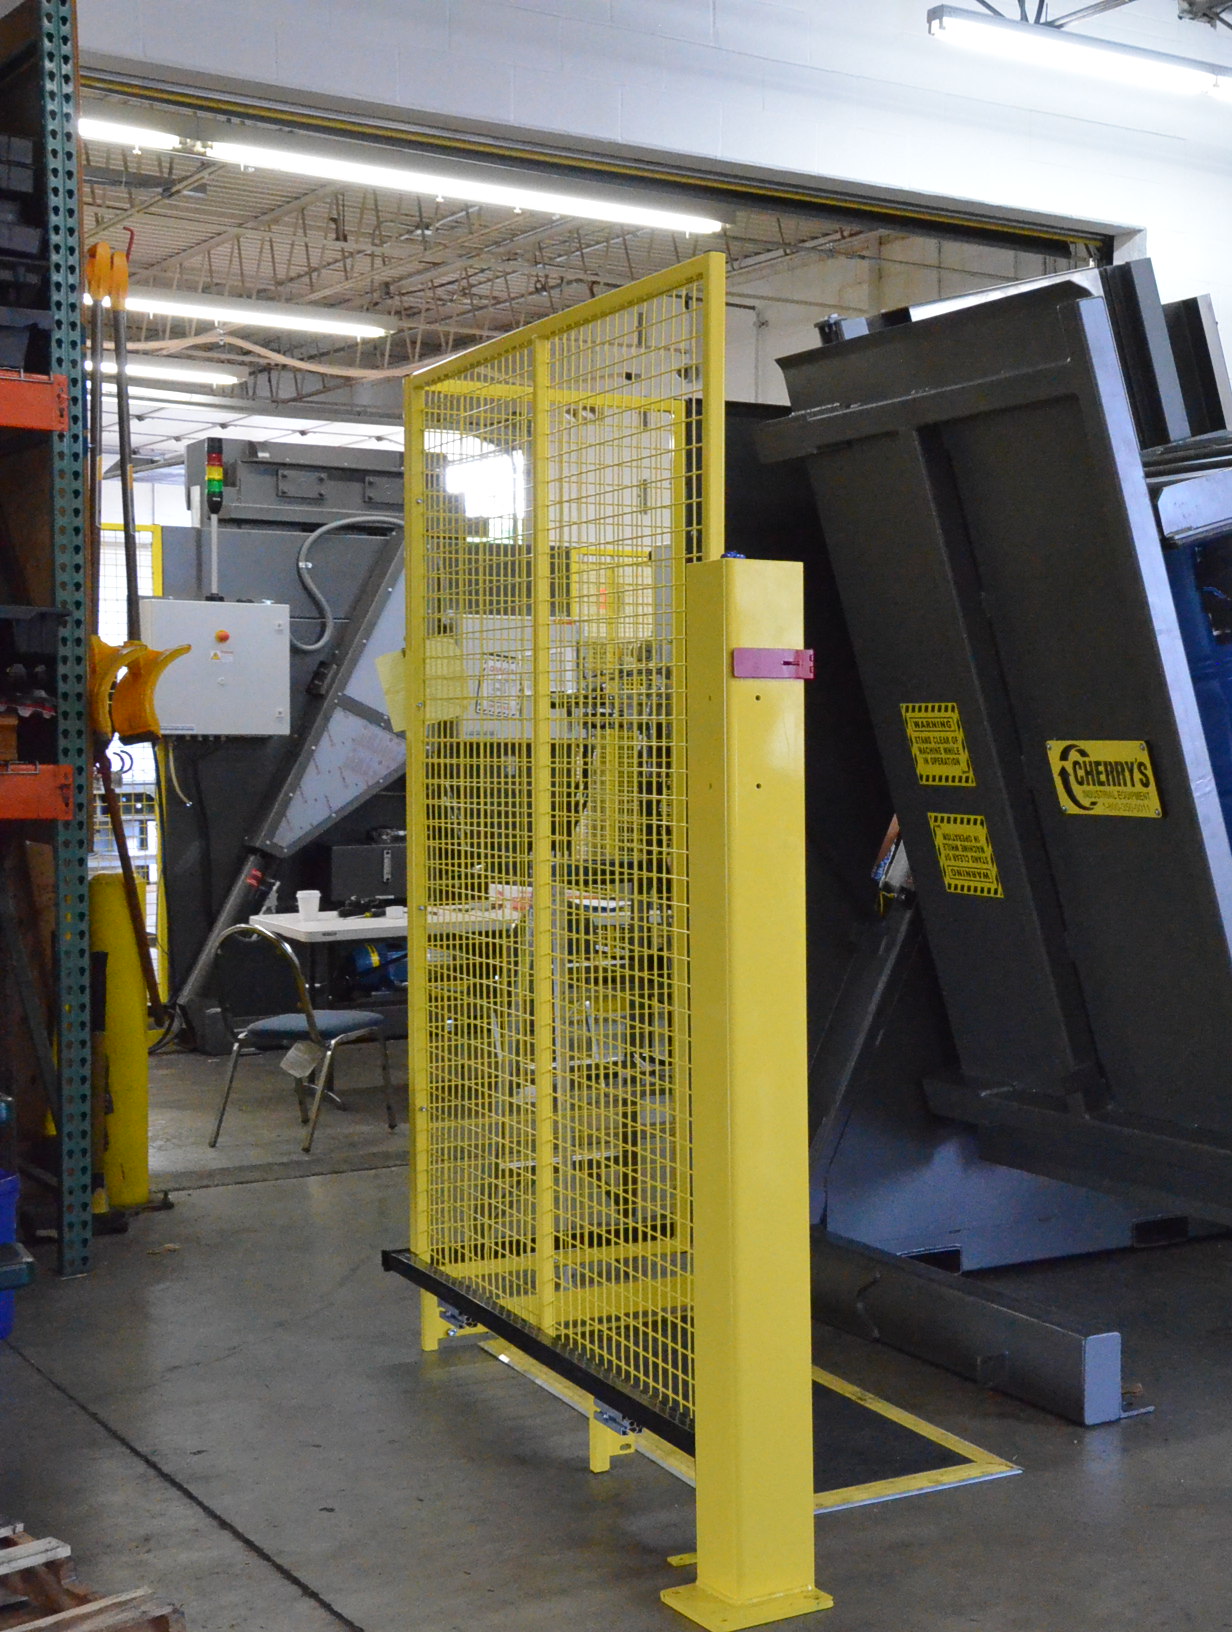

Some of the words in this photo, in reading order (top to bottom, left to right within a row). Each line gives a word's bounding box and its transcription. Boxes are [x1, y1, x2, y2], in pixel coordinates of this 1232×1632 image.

[913, 720, 952, 729] WARNING
[914, 736, 931, 745] STAND
[932, 736, 950, 745] CLEAR
[951, 736, 959, 745] OF
[917, 746, 943, 755] MACHINE
[943, 746, 960, 756] WHILE
[922, 757, 929, 765] IN
[930, 757, 961, 766] OPERATION
[1072, 758, 1151, 789] CHERRY'S
[1082, 789, 1116, 800] INDUSTRIAL
[1117, 790, 1151, 801] EQUIPMENT
[942, 833, 972, 843] OPERATION
[960, 844, 986, 855] MACHINE
[952, 854, 970, 864] CLEAR
[971, 855, 989, 865] STAND
[950, 868, 991, 880] WARNING
